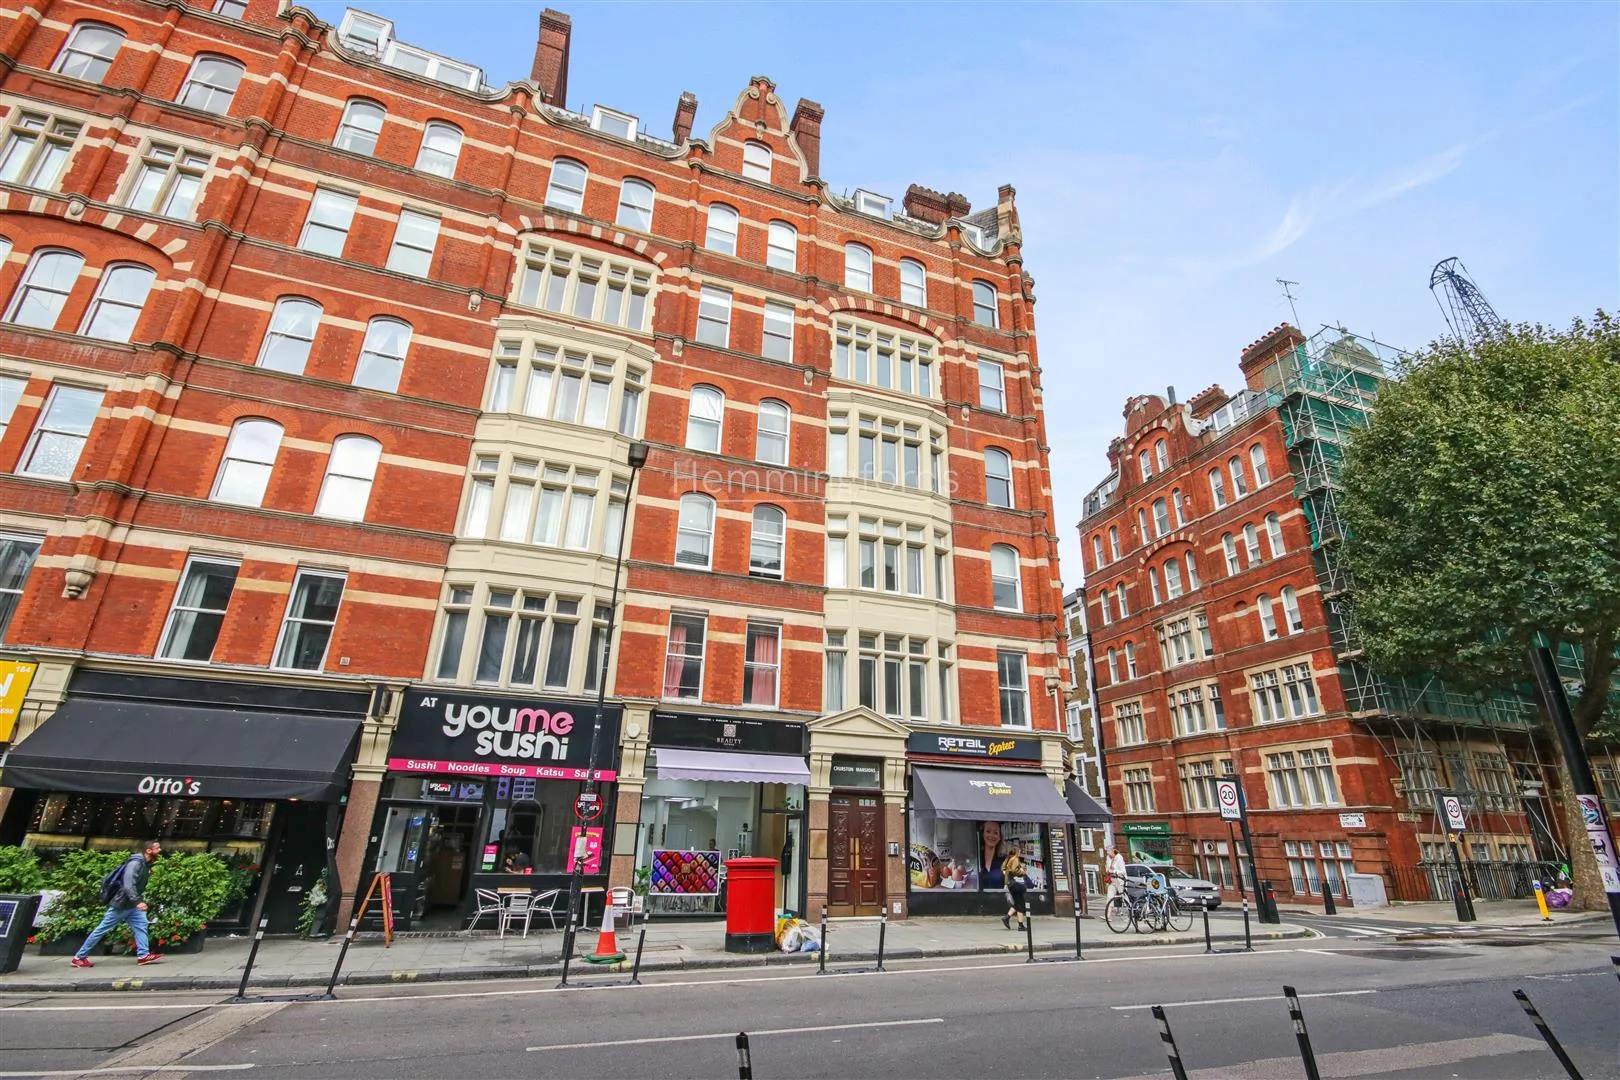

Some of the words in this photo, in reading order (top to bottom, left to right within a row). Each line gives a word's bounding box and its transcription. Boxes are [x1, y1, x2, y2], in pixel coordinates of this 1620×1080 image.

[420, 697, 438, 708] AT
[442, 703, 575, 737] youme
[474, 730, 569, 760] sushi
[716, 737, 742, 745] BEAUTY
[407, 760, 437, 770] Sushi
[447, 762, 490, 774] Noodles
[500, 765, 526, 776] Soup
[536, 767, 564, 777] Katsu
[574, 769, 601, 779] Sald
[137, 776, 200, 796] Otto's
[1222, 790, 1234, 800] 20
[1449, 804, 1458, 813] 20
